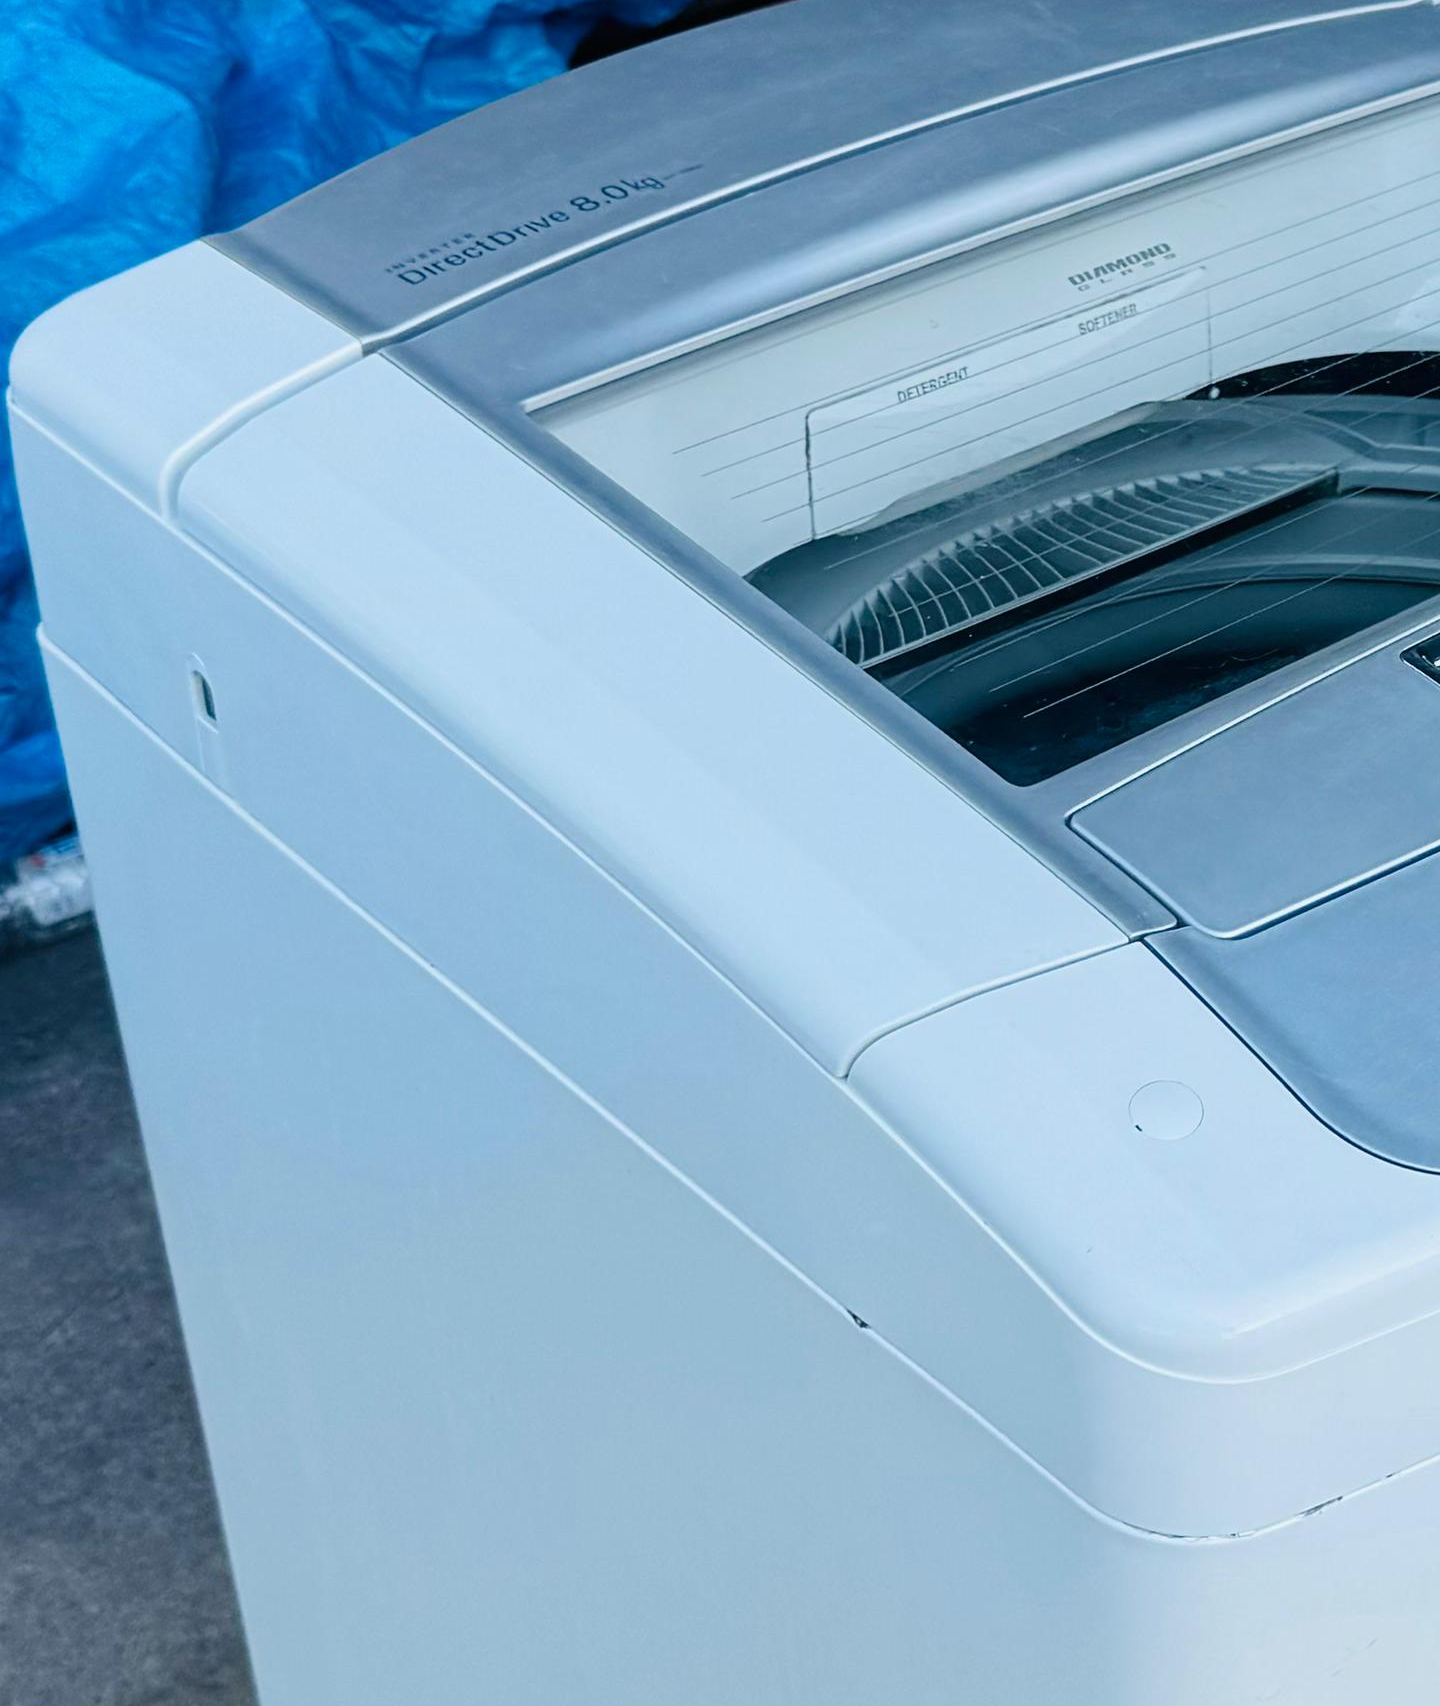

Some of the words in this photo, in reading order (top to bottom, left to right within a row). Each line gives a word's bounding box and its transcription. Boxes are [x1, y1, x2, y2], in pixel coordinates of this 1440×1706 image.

[385, 233, 476, 273] INVERTER
[1068, 242, 1172, 287] DIAMOND
[1078, 303, 1138, 336] SOFTENER
[897, 366, 970, 404] DETERGENT
